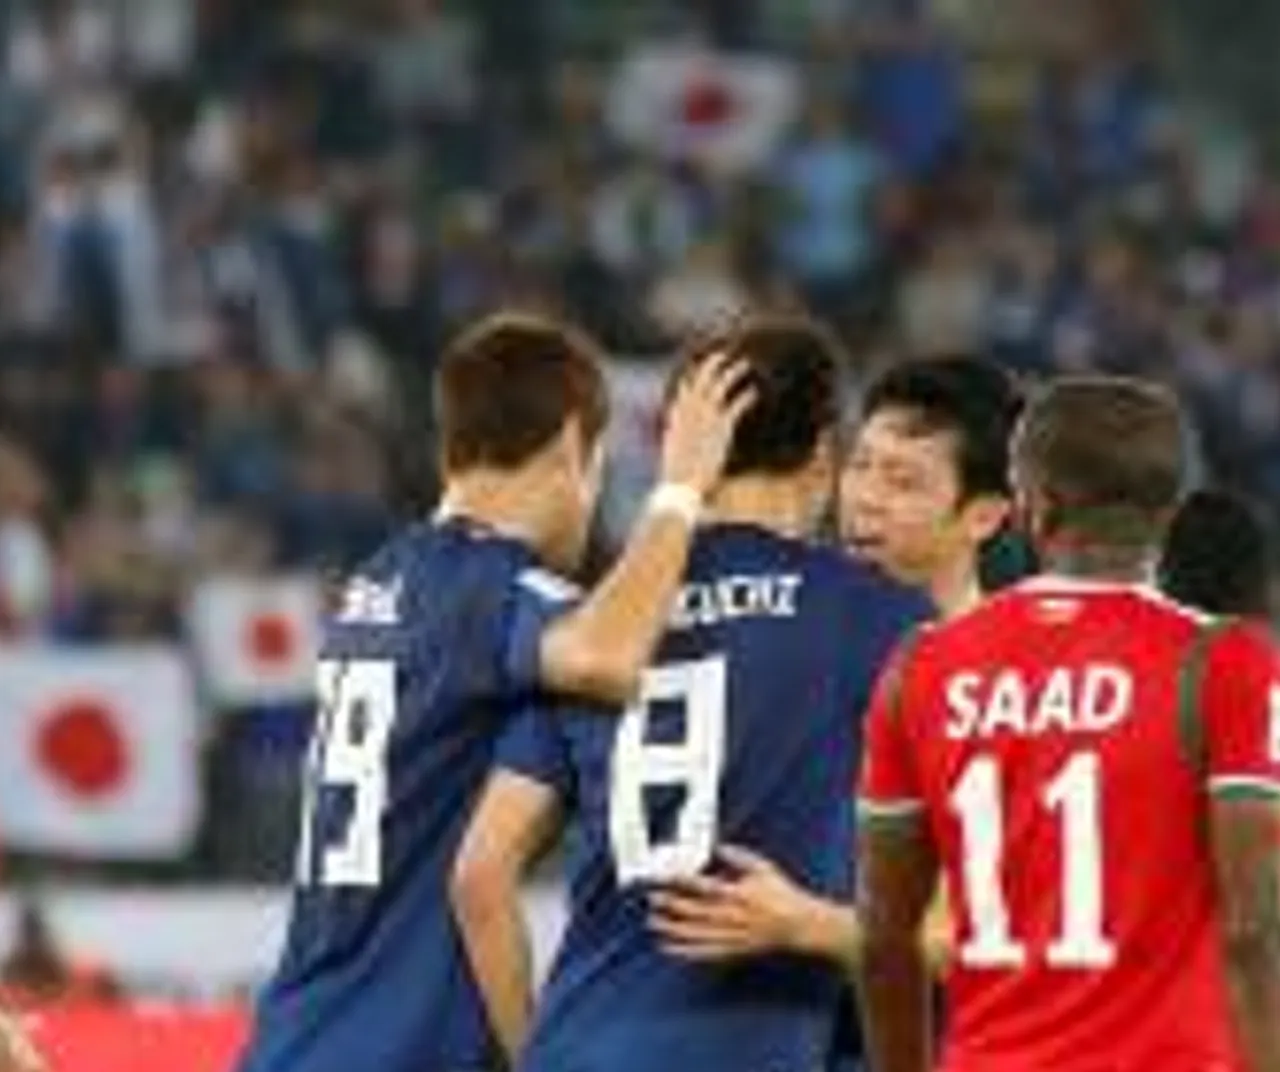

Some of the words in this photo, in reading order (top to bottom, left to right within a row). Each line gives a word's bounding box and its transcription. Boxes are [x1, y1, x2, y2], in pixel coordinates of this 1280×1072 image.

[299, 658, 397, 887] 19
[609, 657, 727, 886] 8
[944, 663, 1134, 740] SAAD
[950, 750, 1117, 968] 11
